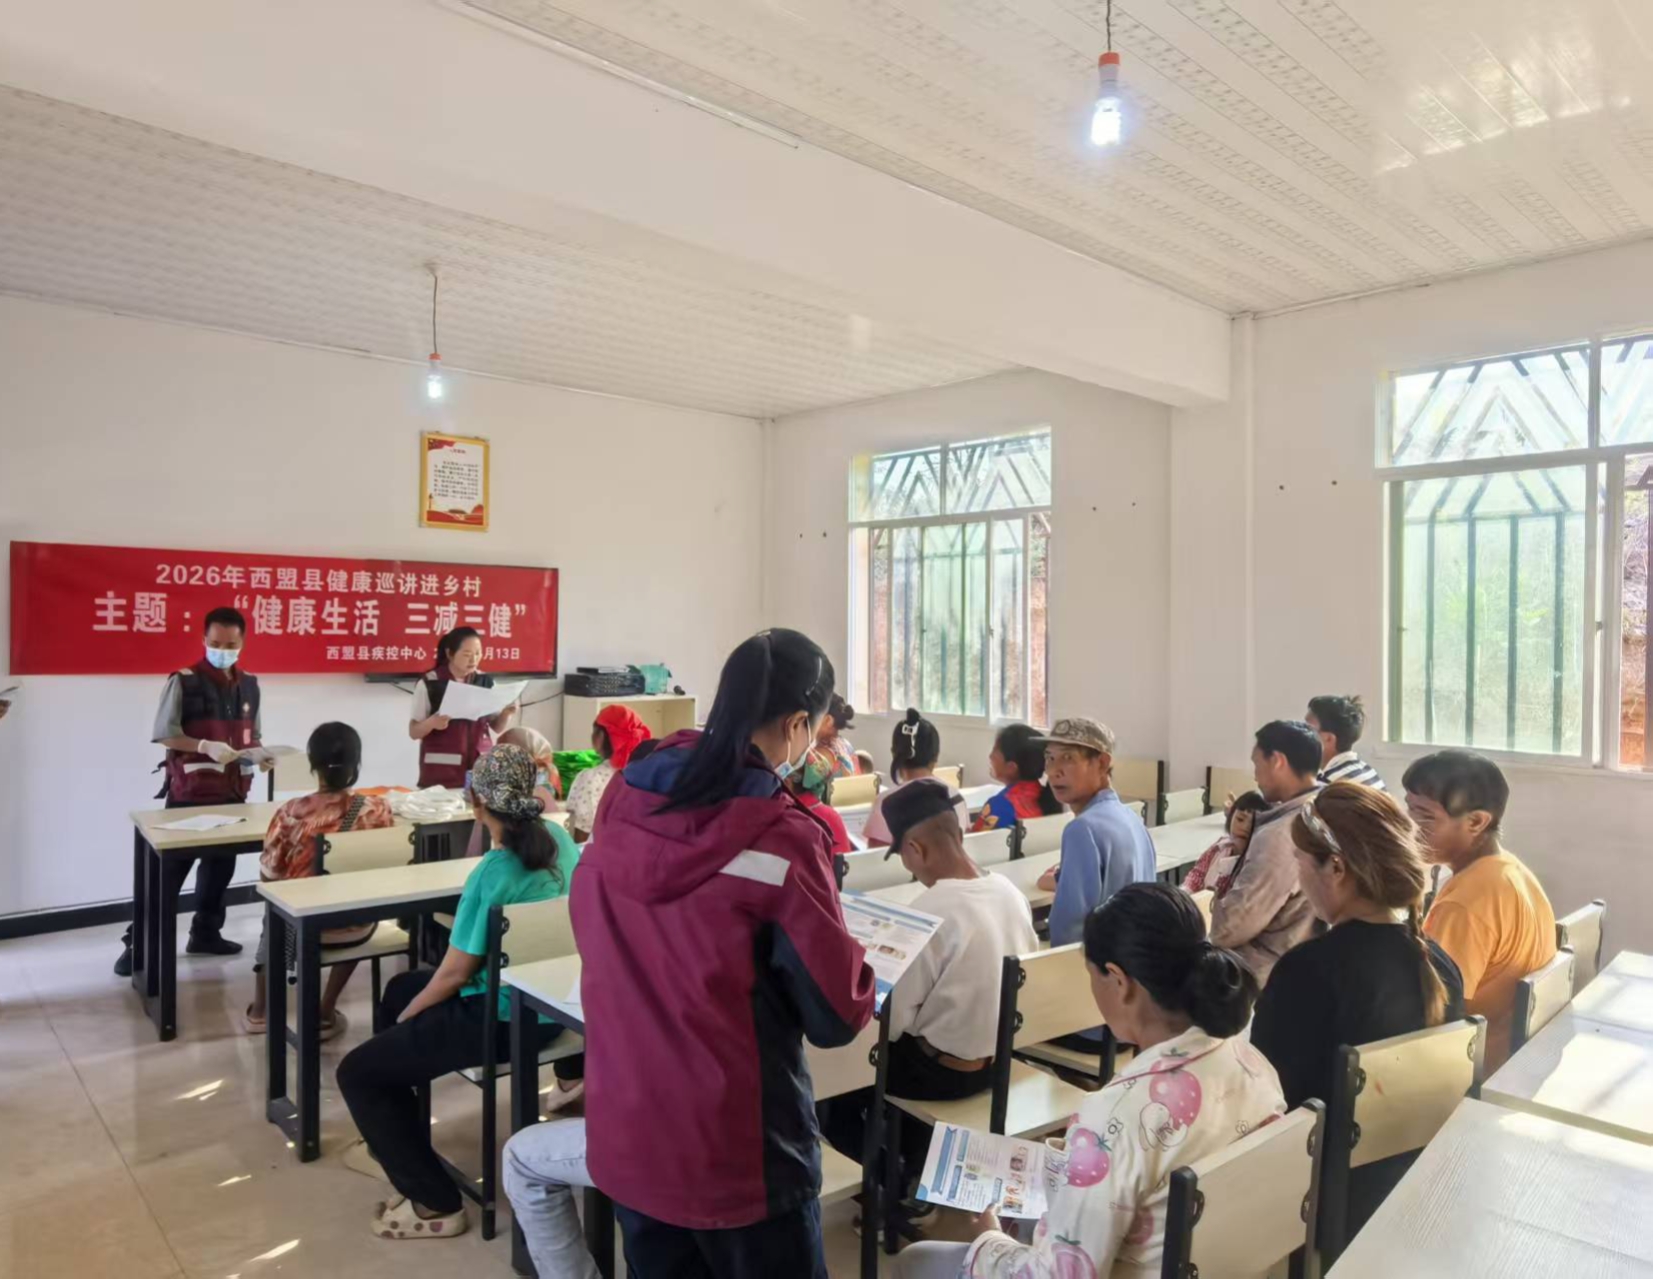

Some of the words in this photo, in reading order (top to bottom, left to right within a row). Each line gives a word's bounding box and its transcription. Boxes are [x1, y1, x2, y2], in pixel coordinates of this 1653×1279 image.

[155, 563, 482, 598] 2026年西盟县健康巡讲进乡村
[92, 590, 191, 634] 主题：
[326, 645, 427, 661] 西盟县疾控中心
